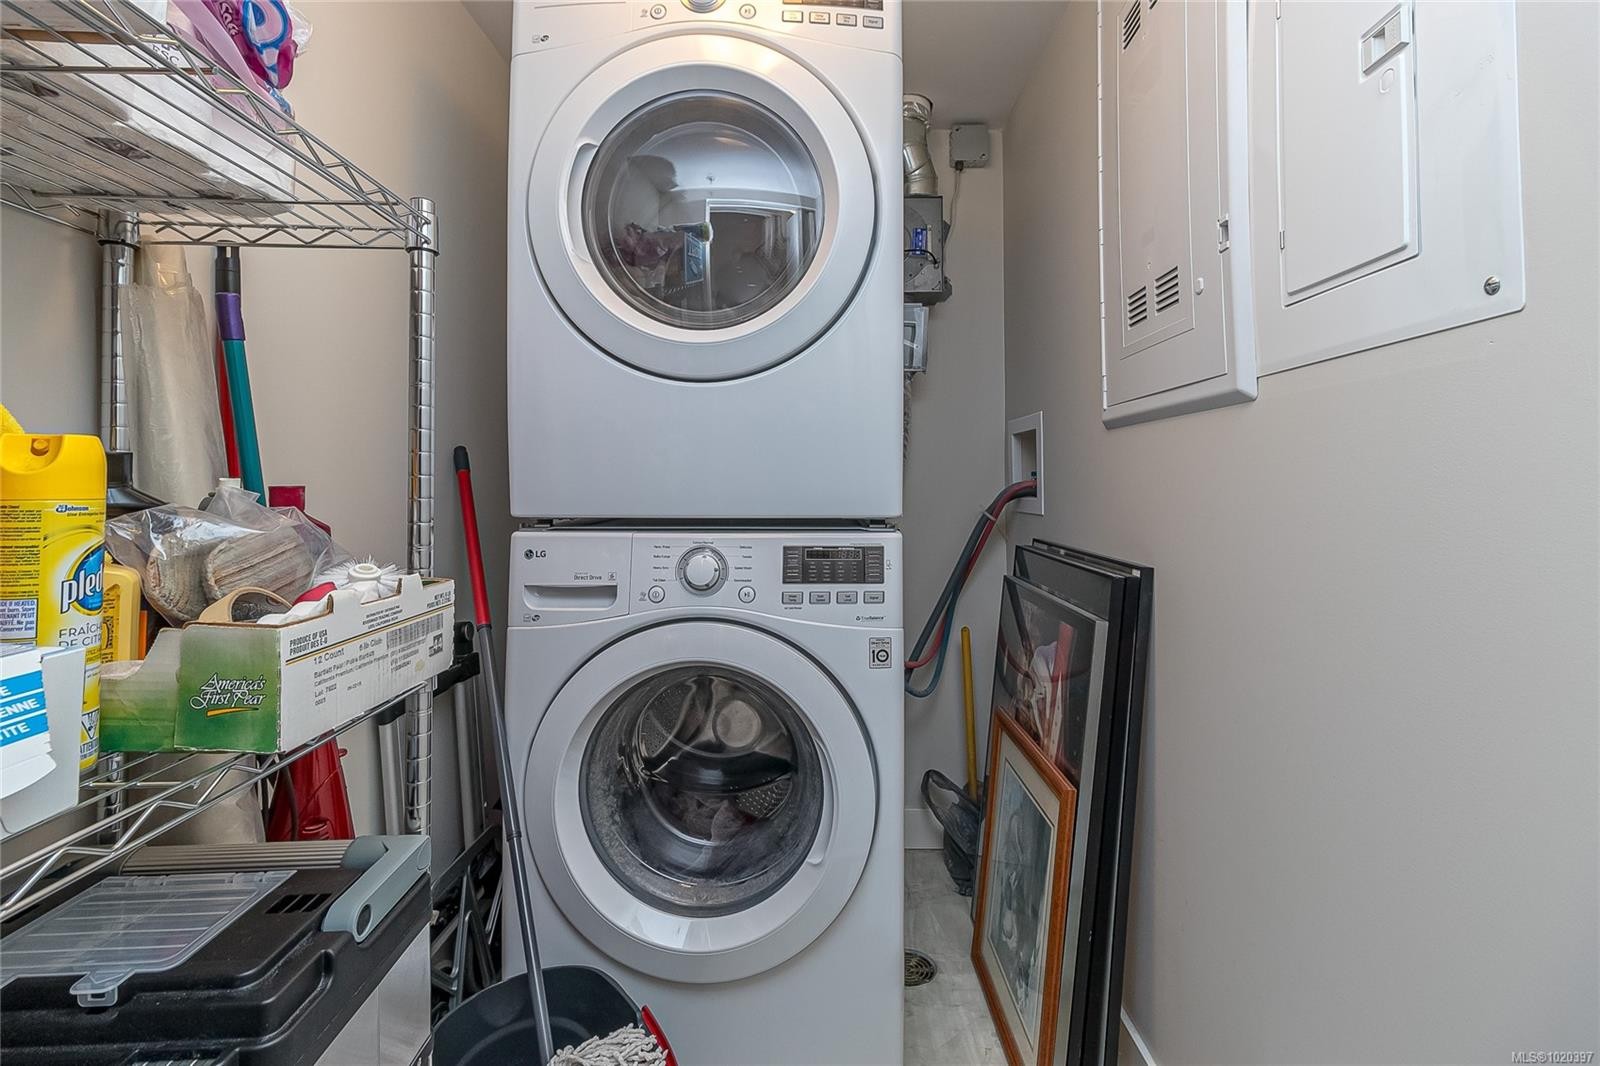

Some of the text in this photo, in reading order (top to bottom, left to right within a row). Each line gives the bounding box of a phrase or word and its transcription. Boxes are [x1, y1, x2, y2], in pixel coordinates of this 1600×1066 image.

[535, 550, 547, 558] LG
[289, 628, 328, 648] PRODUCE OF USA
[289, 641, 310, 656] PRODUIT
[310, 639, 319, 649] DES
[314, 647, 345, 665] 12 Count
[872, 649, 889, 663] 10
[200, 672, 266, 693] America's
[189, 688, 266, 709] First Pear
